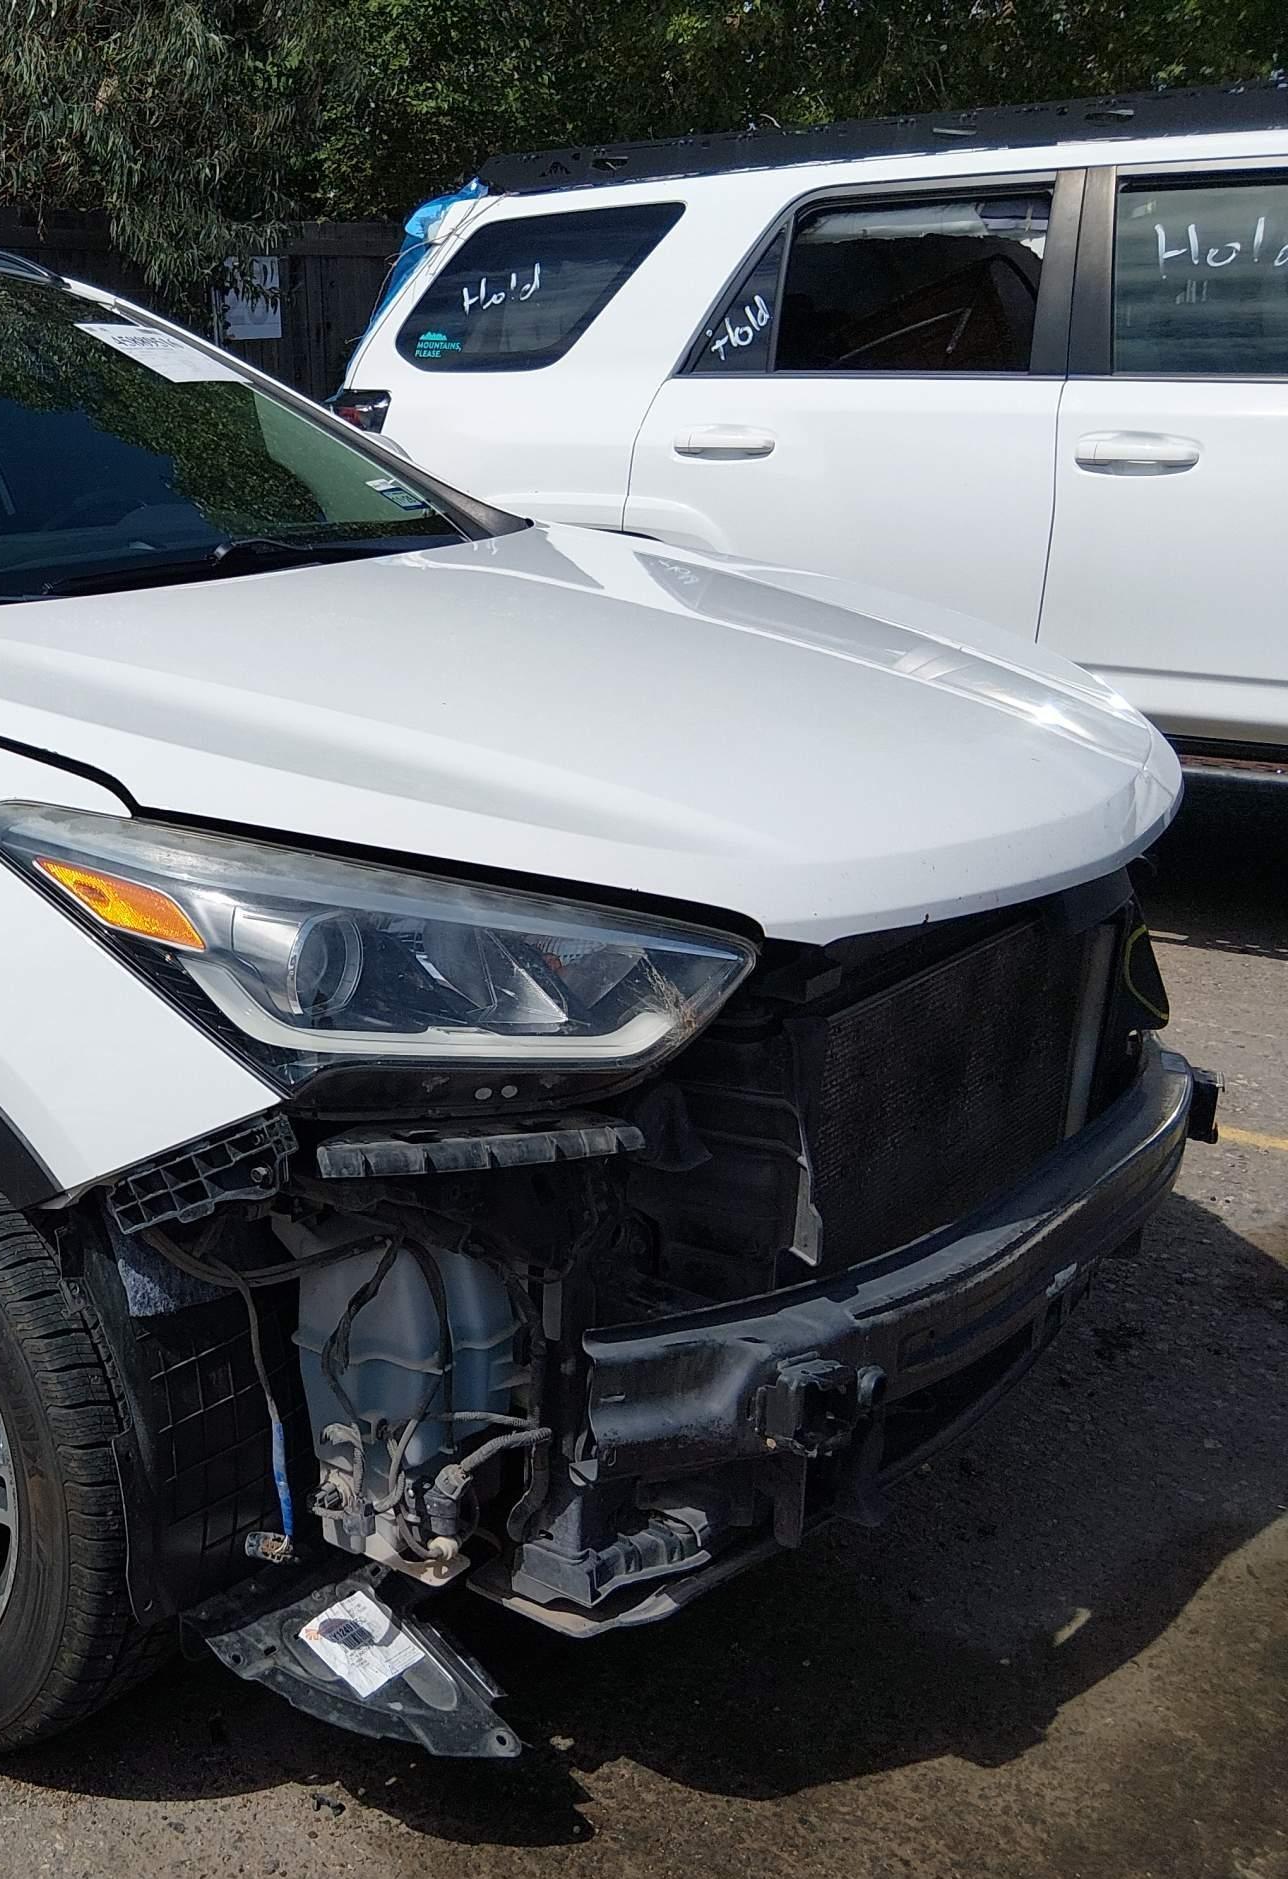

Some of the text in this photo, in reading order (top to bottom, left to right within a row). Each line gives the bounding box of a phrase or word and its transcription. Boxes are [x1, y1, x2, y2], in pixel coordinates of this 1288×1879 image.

[463, 263, 541, 315] Hold
[417, 341, 462, 352] MOUNTAINS,
[706, 295, 771, 361] Hold
